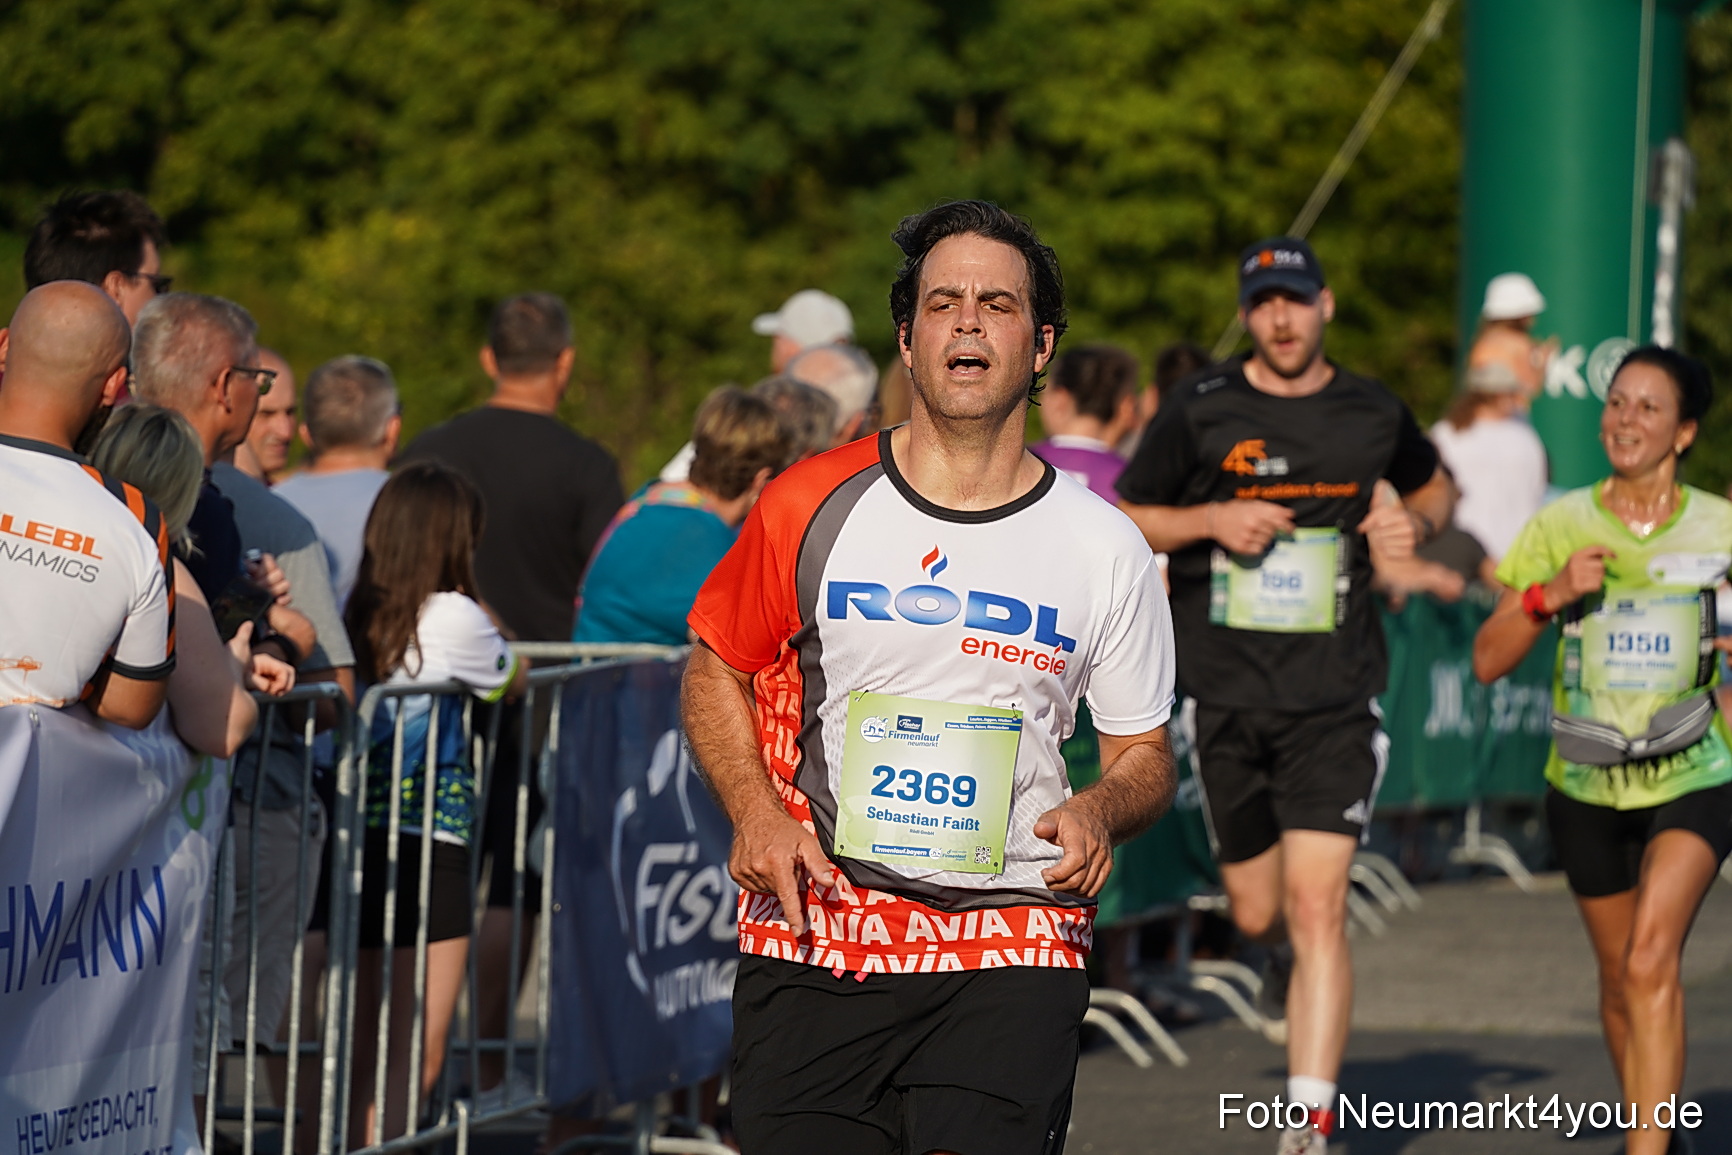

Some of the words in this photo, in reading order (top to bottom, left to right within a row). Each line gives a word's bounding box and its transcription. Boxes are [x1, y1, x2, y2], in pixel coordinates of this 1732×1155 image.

[961, 637, 1066, 676] energie
[888, 731, 940, 742] Firmenlauf
[870, 765, 977, 808] 2369
[866, 806, 939, 828] Sebastian
[942, 816, 980, 832] Faißt
[874, 846, 927, 857] firmenlauf.bayern
[904, 909, 1014, 943] AVIA
